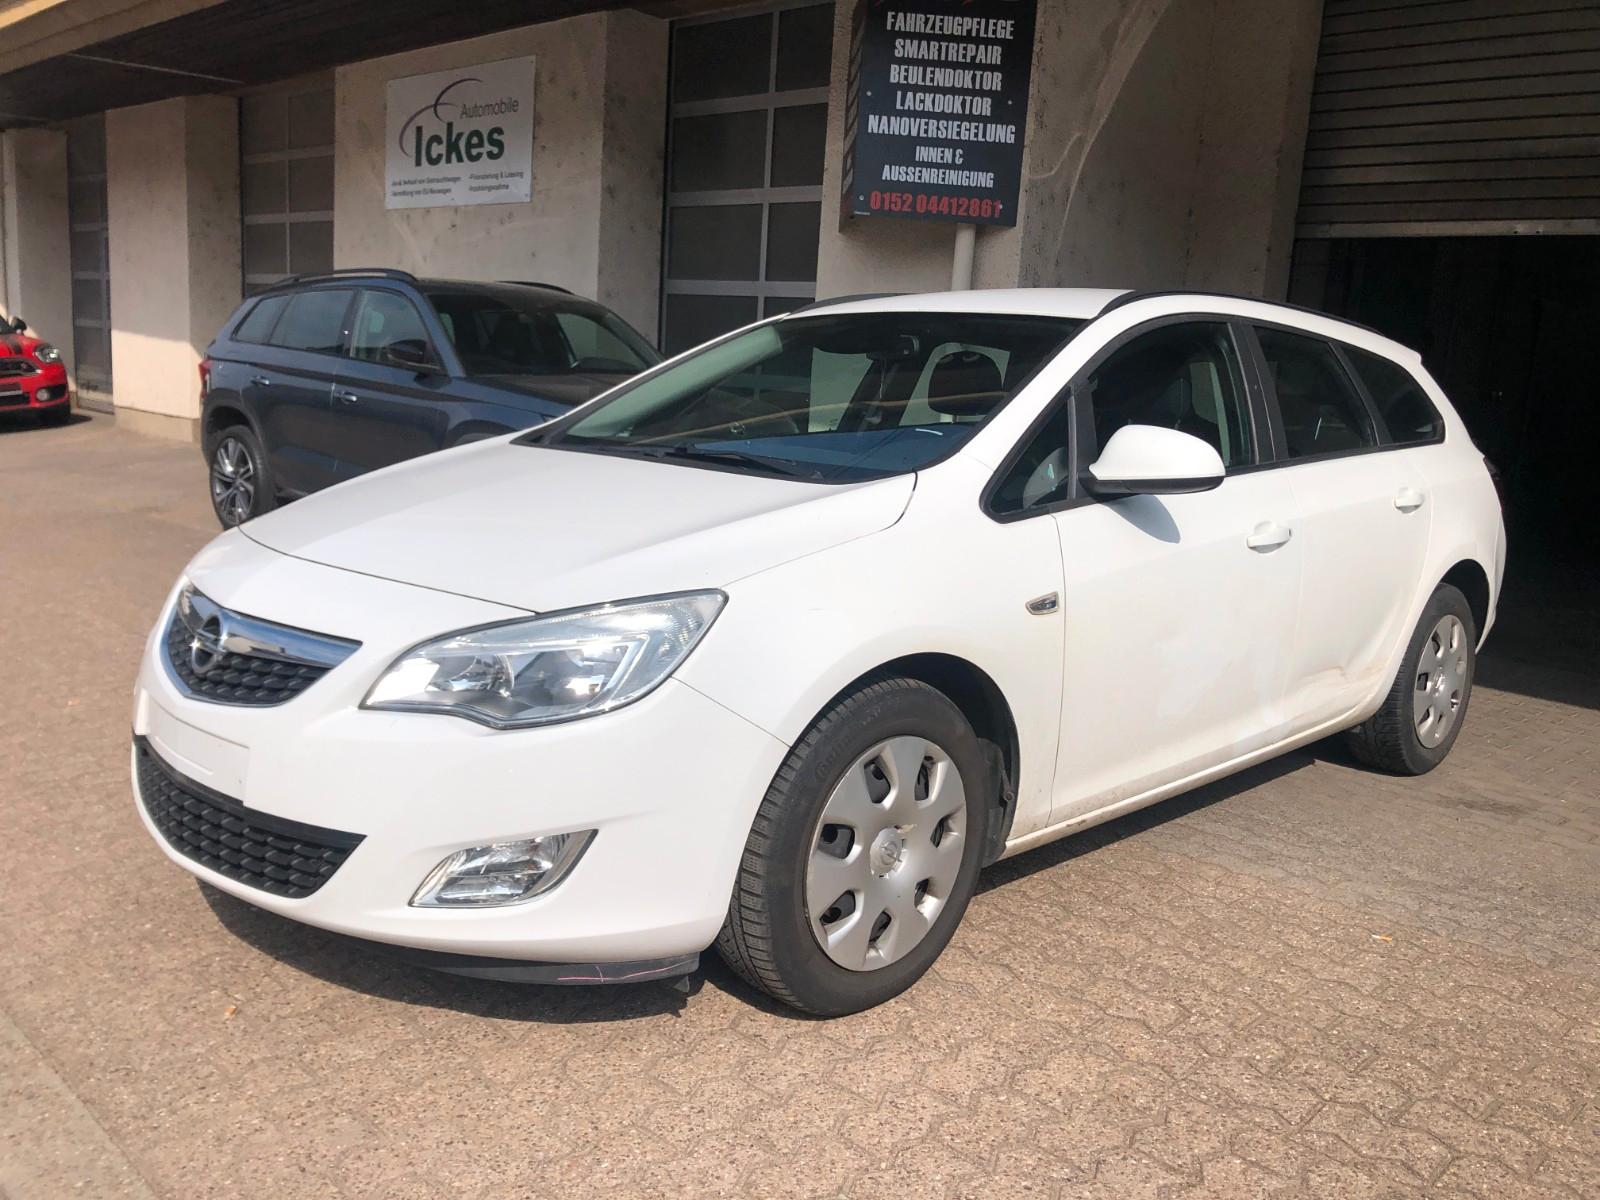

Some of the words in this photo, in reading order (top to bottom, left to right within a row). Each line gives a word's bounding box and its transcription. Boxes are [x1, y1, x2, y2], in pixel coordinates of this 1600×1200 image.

[886, 11, 1015, 39] FAHRZEUGPFLEGE
[894, 38, 1002, 65] SMARTREPAIR
[889, 64, 1003, 91] BEULENDOKTOR
[459, 97, 519, 119] Automobile
[896, 90, 992, 117] LACKDOKTOR
[867, 114, 1016, 144] NANOVERSIEGELUNG
[414, 121, 505, 167] Ickes
[915, 146, 953, 164] INNEN
[955, 149, 964, 165] &
[881, 164, 995, 188] AUSSENREINIGUNG
[869, 191, 913, 212] 0152
